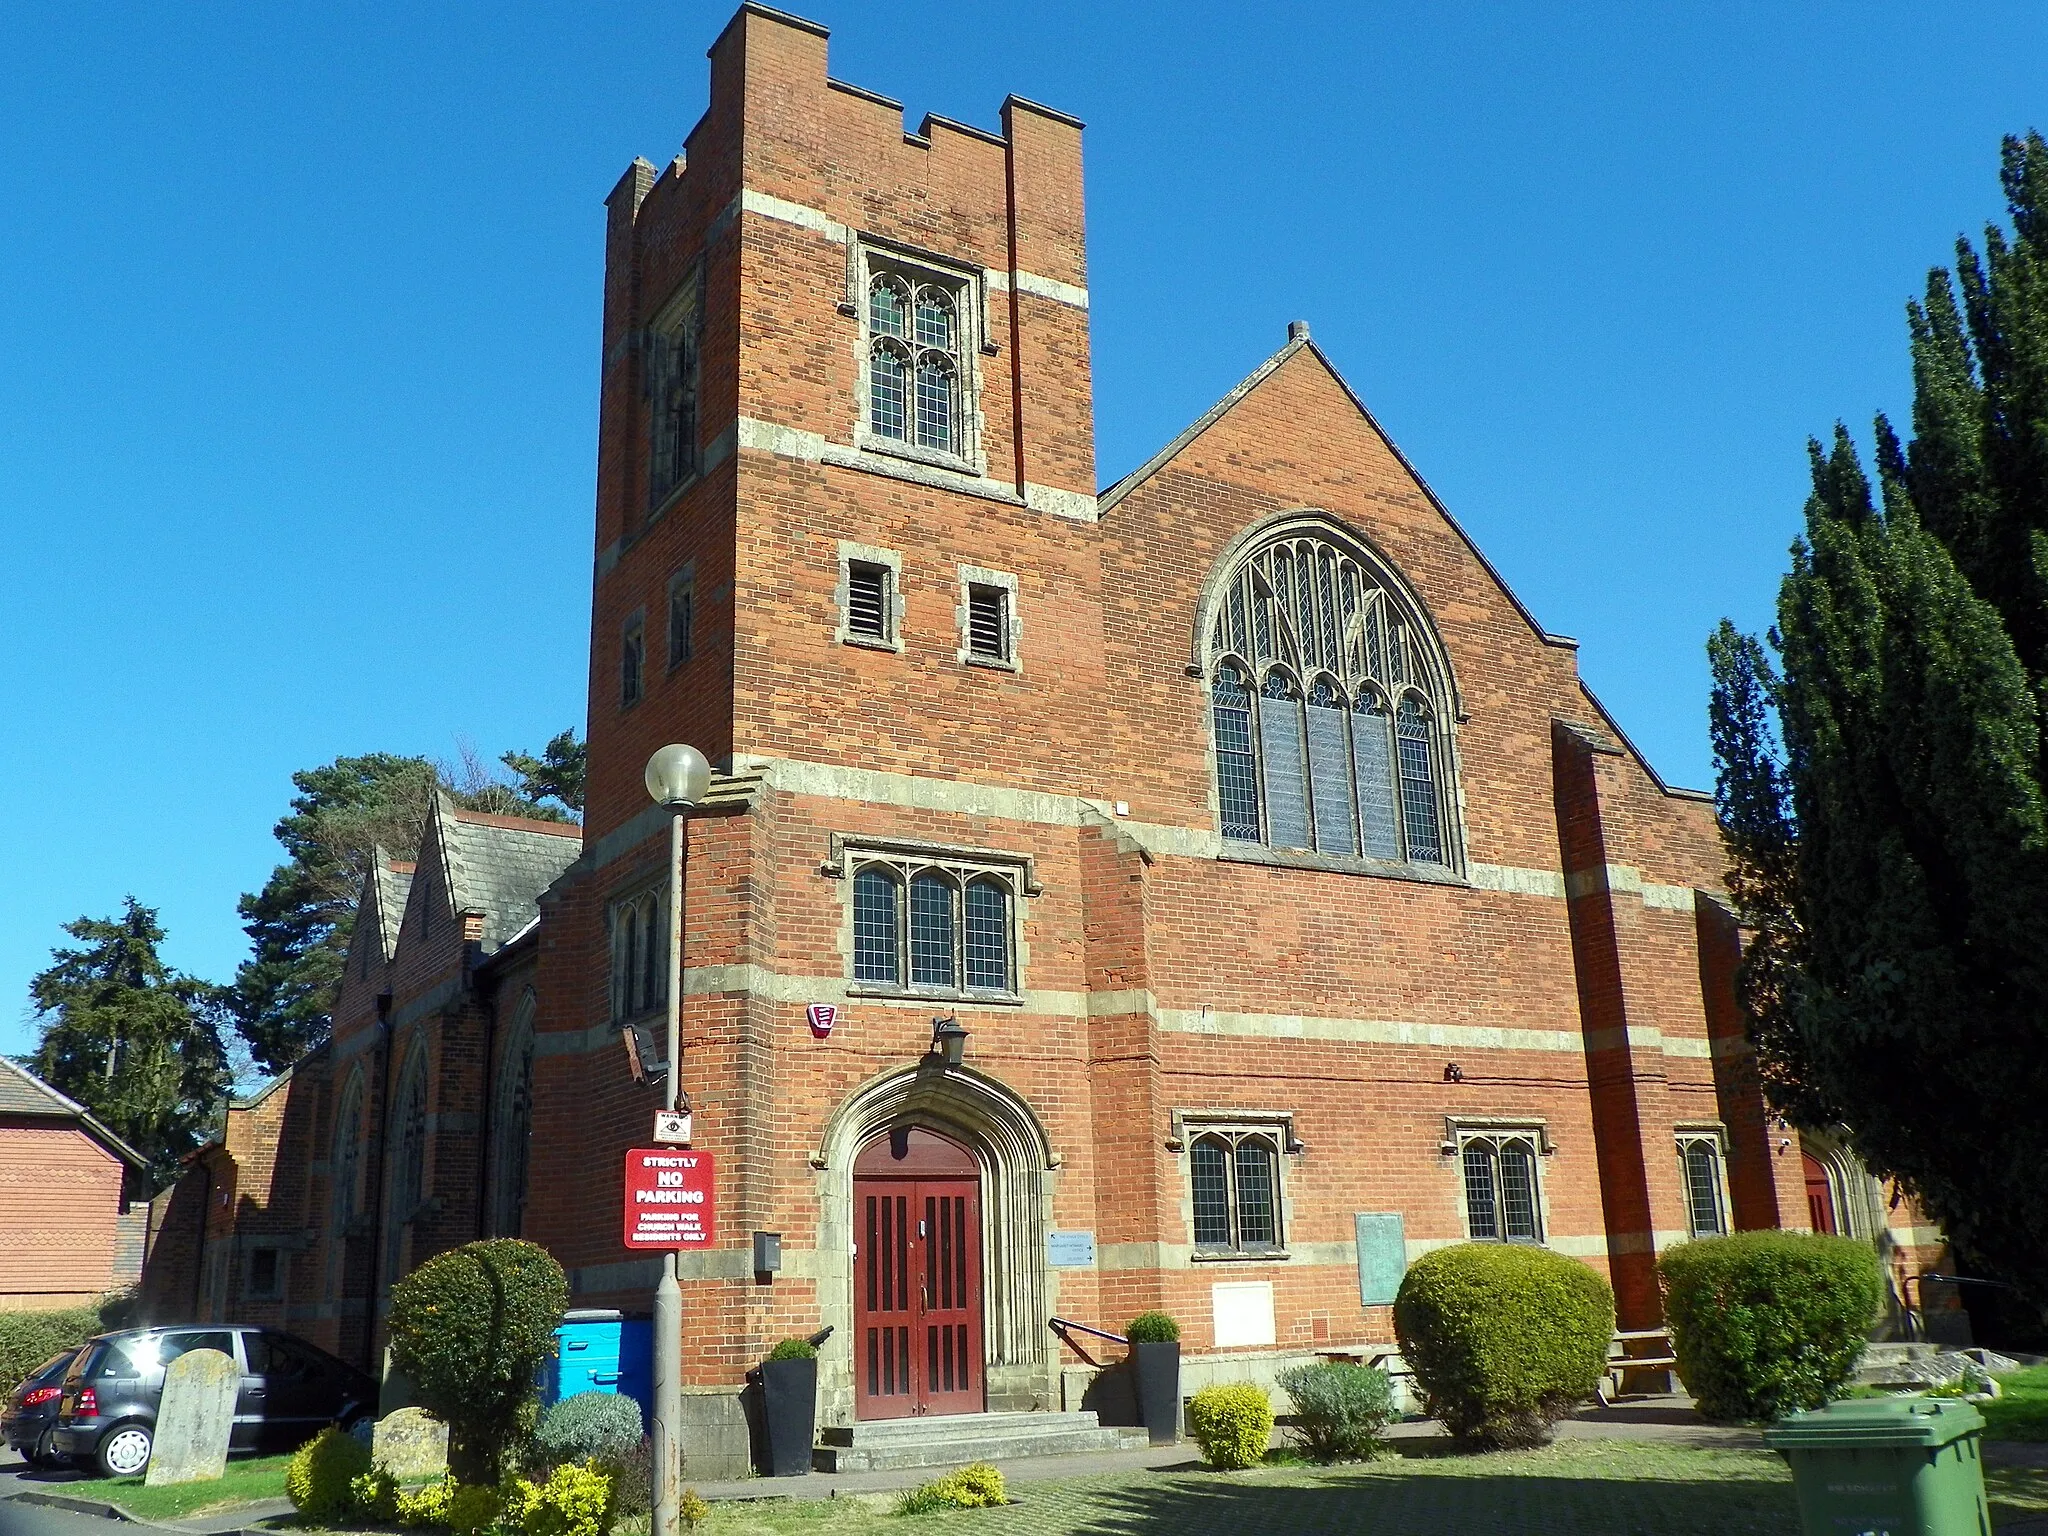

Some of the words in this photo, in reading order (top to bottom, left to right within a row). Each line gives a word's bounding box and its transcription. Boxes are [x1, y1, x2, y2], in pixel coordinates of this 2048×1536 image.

[642, 1157, 698, 1168] STRICTLY
[658, 1171, 683, 1185] NO
[636, 1190, 704, 1204] PARKING
[640, 1213, 680, 1221] PARKING
[681, 1213, 699, 1221] FOR
[637, 1223, 675, 1231] CHURCH
[676, 1223, 701, 1231] WALK
[682, 1233, 706, 1241] ONLY
